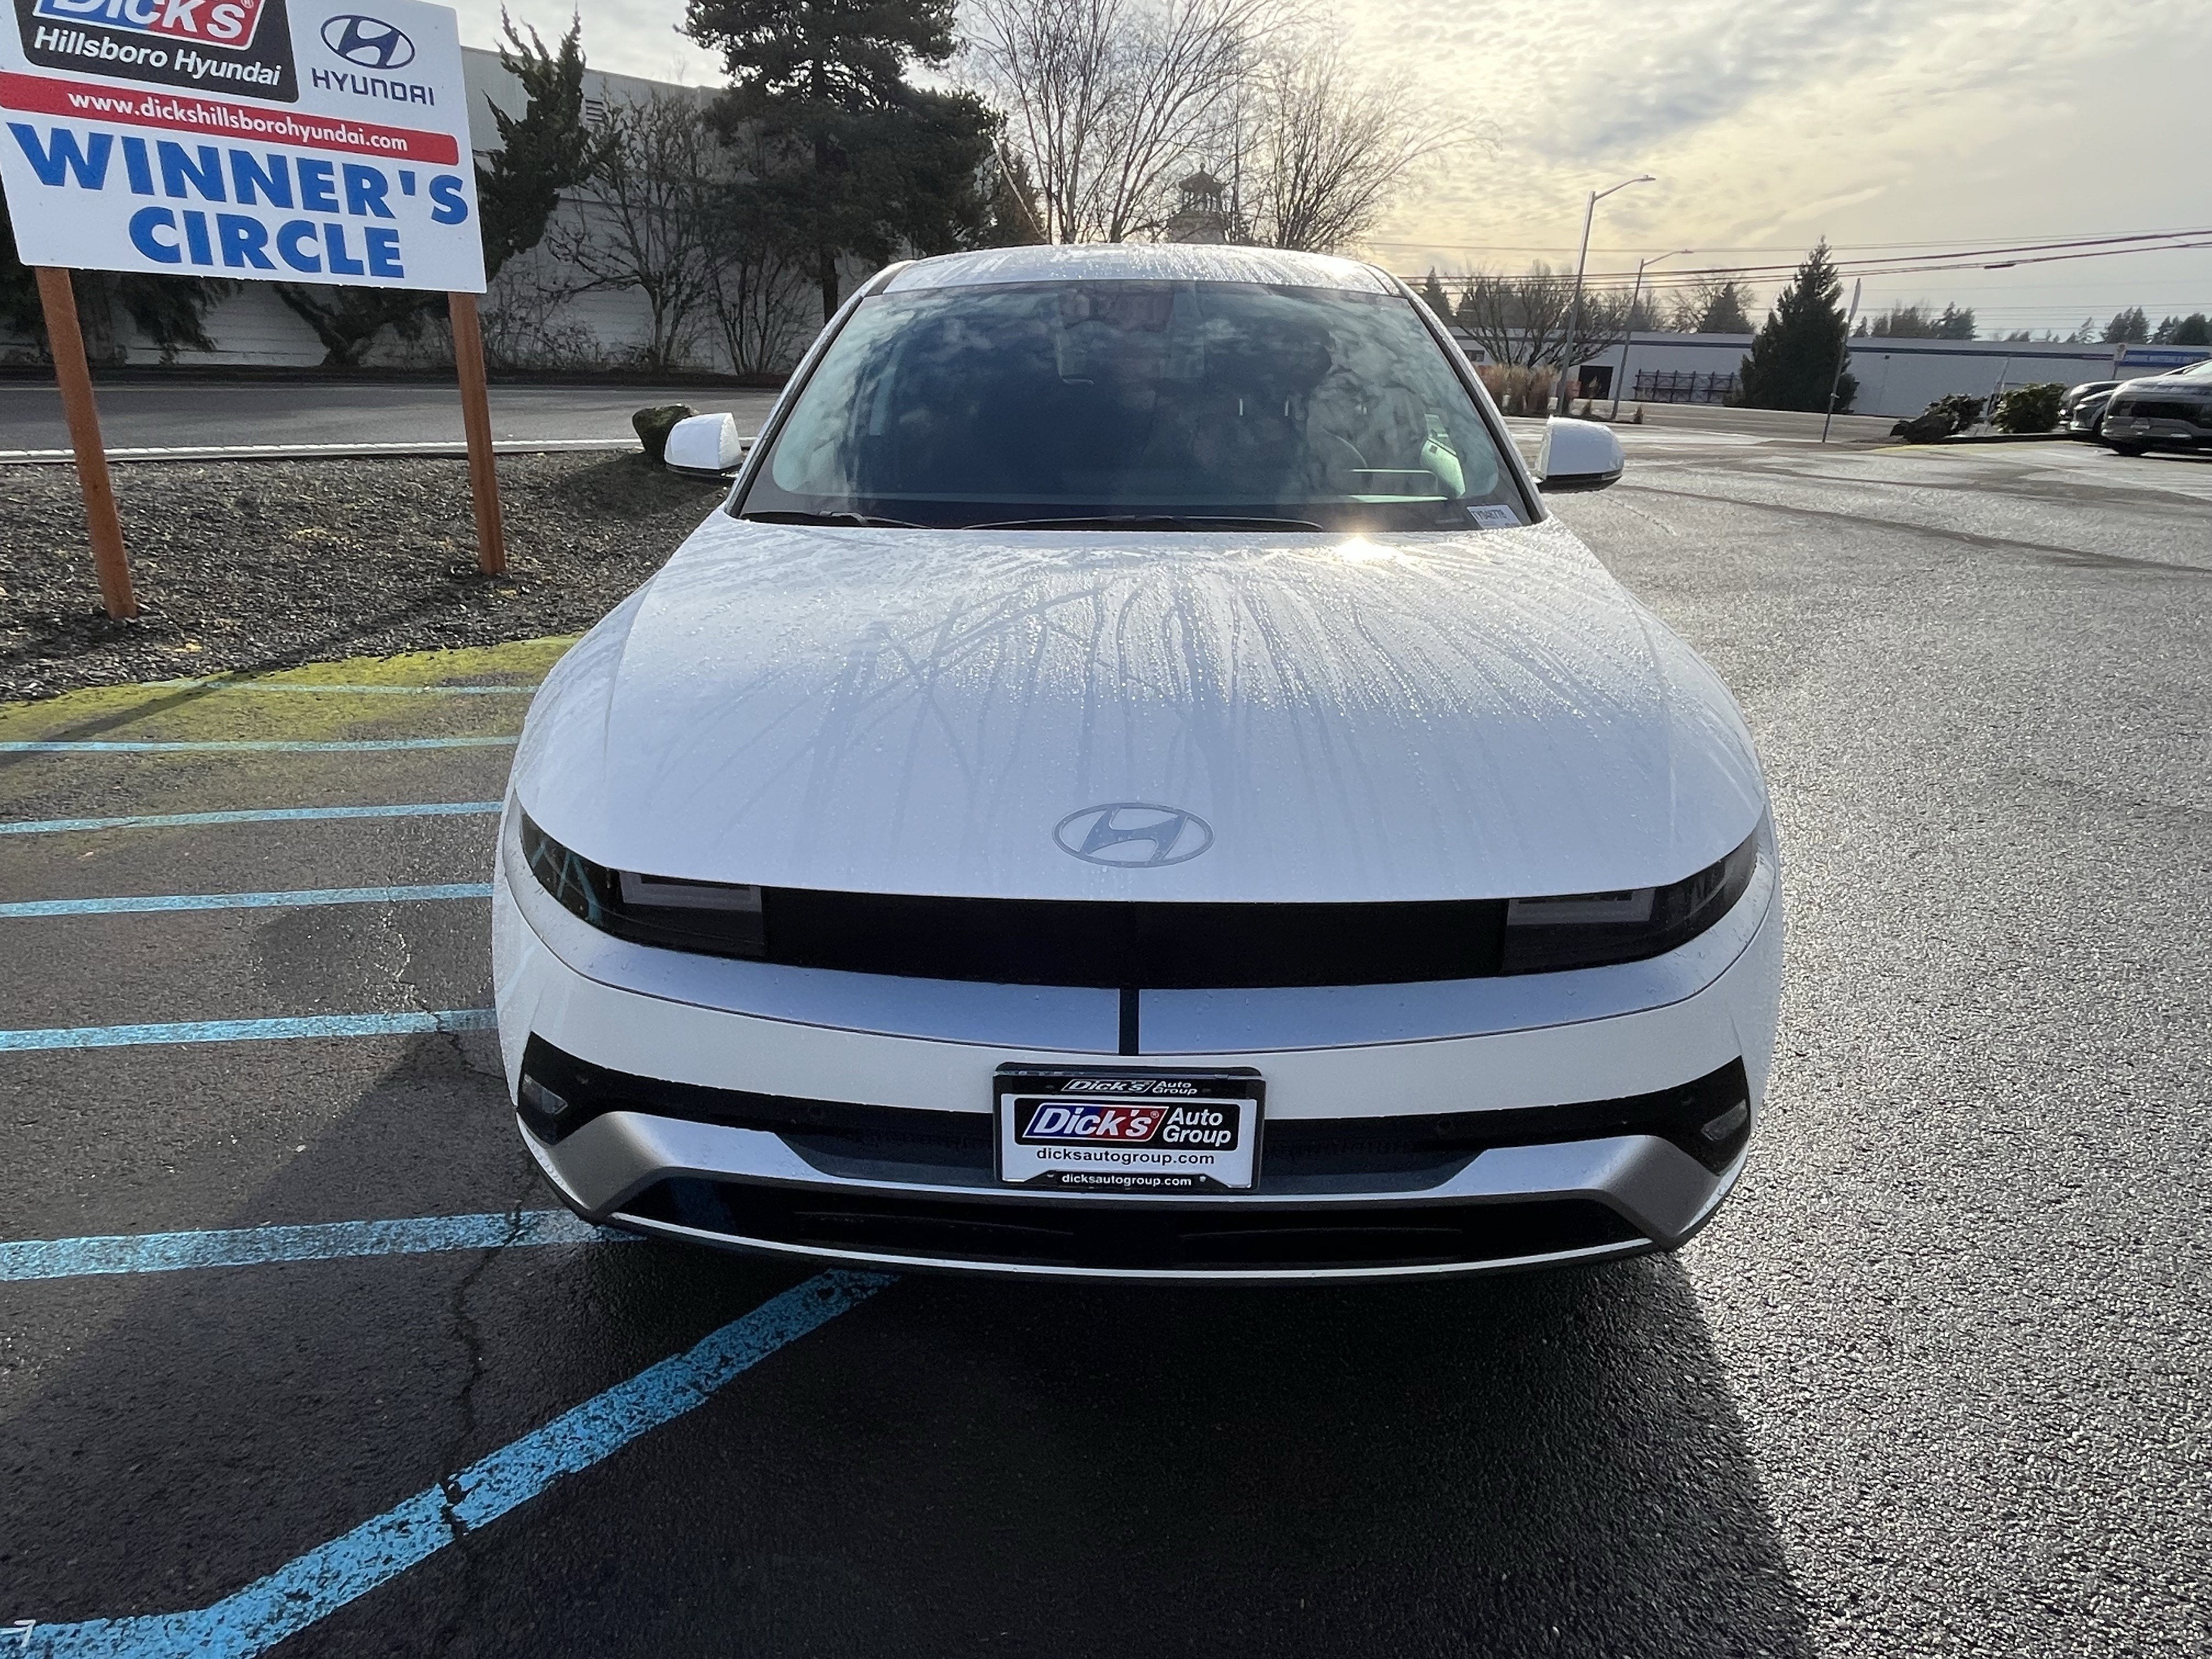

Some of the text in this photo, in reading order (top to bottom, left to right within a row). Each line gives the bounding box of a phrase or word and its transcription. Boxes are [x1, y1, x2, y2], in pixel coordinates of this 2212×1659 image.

[34, 26, 282, 86] Hillsboro Hyundai
[312, 67, 435, 106] HYUNDAI
[67, 93, 408, 151] www.dickshillsborohyundai.com
[7, 122, 469, 224] WINNER'S
[129, 206, 405, 278] CIRCLE
[1069, 1081, 1144, 1091] Dick's
[1153, 1087, 1198, 1096] Group
[1034, 1108, 1153, 1137] Dick's
[1168, 1108, 1223, 1126] Auto
[1163, 1126, 1231, 1147] Group
[1036, 1148, 1215, 1165] dicksautogroup.com
[1062, 1173, 1192, 1187] dicksautogroup.com
